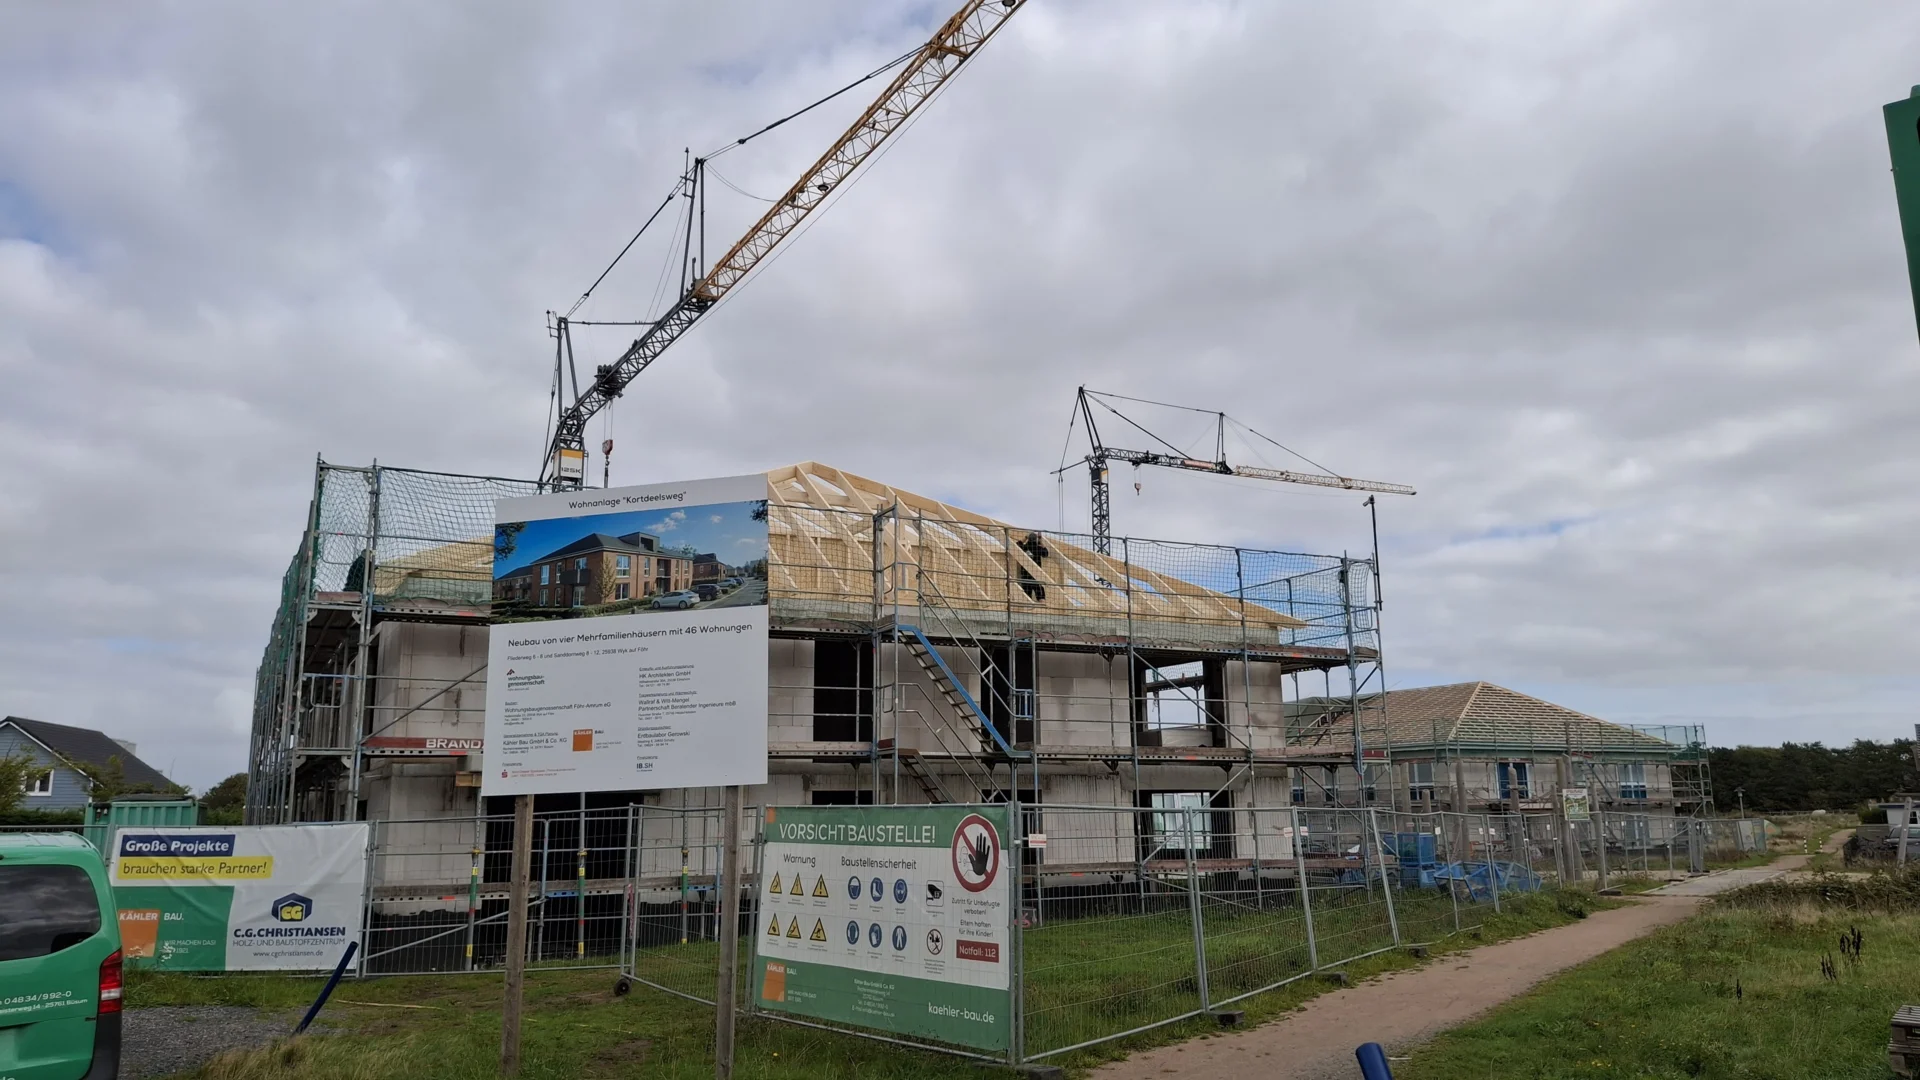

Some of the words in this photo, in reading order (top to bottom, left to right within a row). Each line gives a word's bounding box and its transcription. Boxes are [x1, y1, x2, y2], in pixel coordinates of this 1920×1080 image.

[569, 497, 621, 510] Wohnanlage
[623, 491, 687, 505] "Kortdeelsweg"
[508, 638, 541, 647] Neubau
[542, 637, 558, 645] von
[559, 635, 574, 643] vier
[577, 629, 667, 642] Mehrfamilienhäusern
[669, 627, 683, 636] mit
[685, 626, 697, 635] 46
[700, 623, 753, 634] Wohnungen
[554, 650, 585, 658] Sanddornweg
[617, 647, 628, 655] Wyk
[647, 671, 674, 679] Architekten
[504, 704, 573, 713] Wohnungsbaugenossenschaft
[638, 704, 670, 712] Partnerschaft
[425, 738, 485, 749] BRAND
[636, 762, 654, 770] IB.SH
[779, 823, 846, 842] VORSICHT
[849, 824, 936, 844] BAUSTELLE!
[125, 839, 167, 852] Große
[170, 840, 230, 855] Projekte
[784, 853, 817, 868] Warnung
[841, 855, 917, 871] Baustellensicherheit
[123, 862, 179, 875] brauchen
[180, 862, 215, 875] starke
[218, 861, 268, 874] Partner!
[951, 897, 966, 905] Zutritt
[973, 899, 1001, 909] Unbefugte
[119, 910, 159, 921] KÄHLER
[164, 912, 185, 921] BAU.
[280, 905, 303, 920] CG
[964, 908, 987, 916] verboten!
[974, 920, 992, 928] haften
[233, 926, 346, 938] C.G.CHRISTIANSEN
[975, 930, 994, 938] Kinder!
[233, 938, 254, 947] HOLZ-
[256, 939, 274, 947] UND
[275, 938, 345, 947] BAUSTOFFZENTRUM
[253, 949, 324, 959] www.cgchristiansen.de
[959, 945, 984, 956] Notfall:
[985, 948, 997, 958] 112
[928, 1002, 995, 1023] kaehler-bau.de
